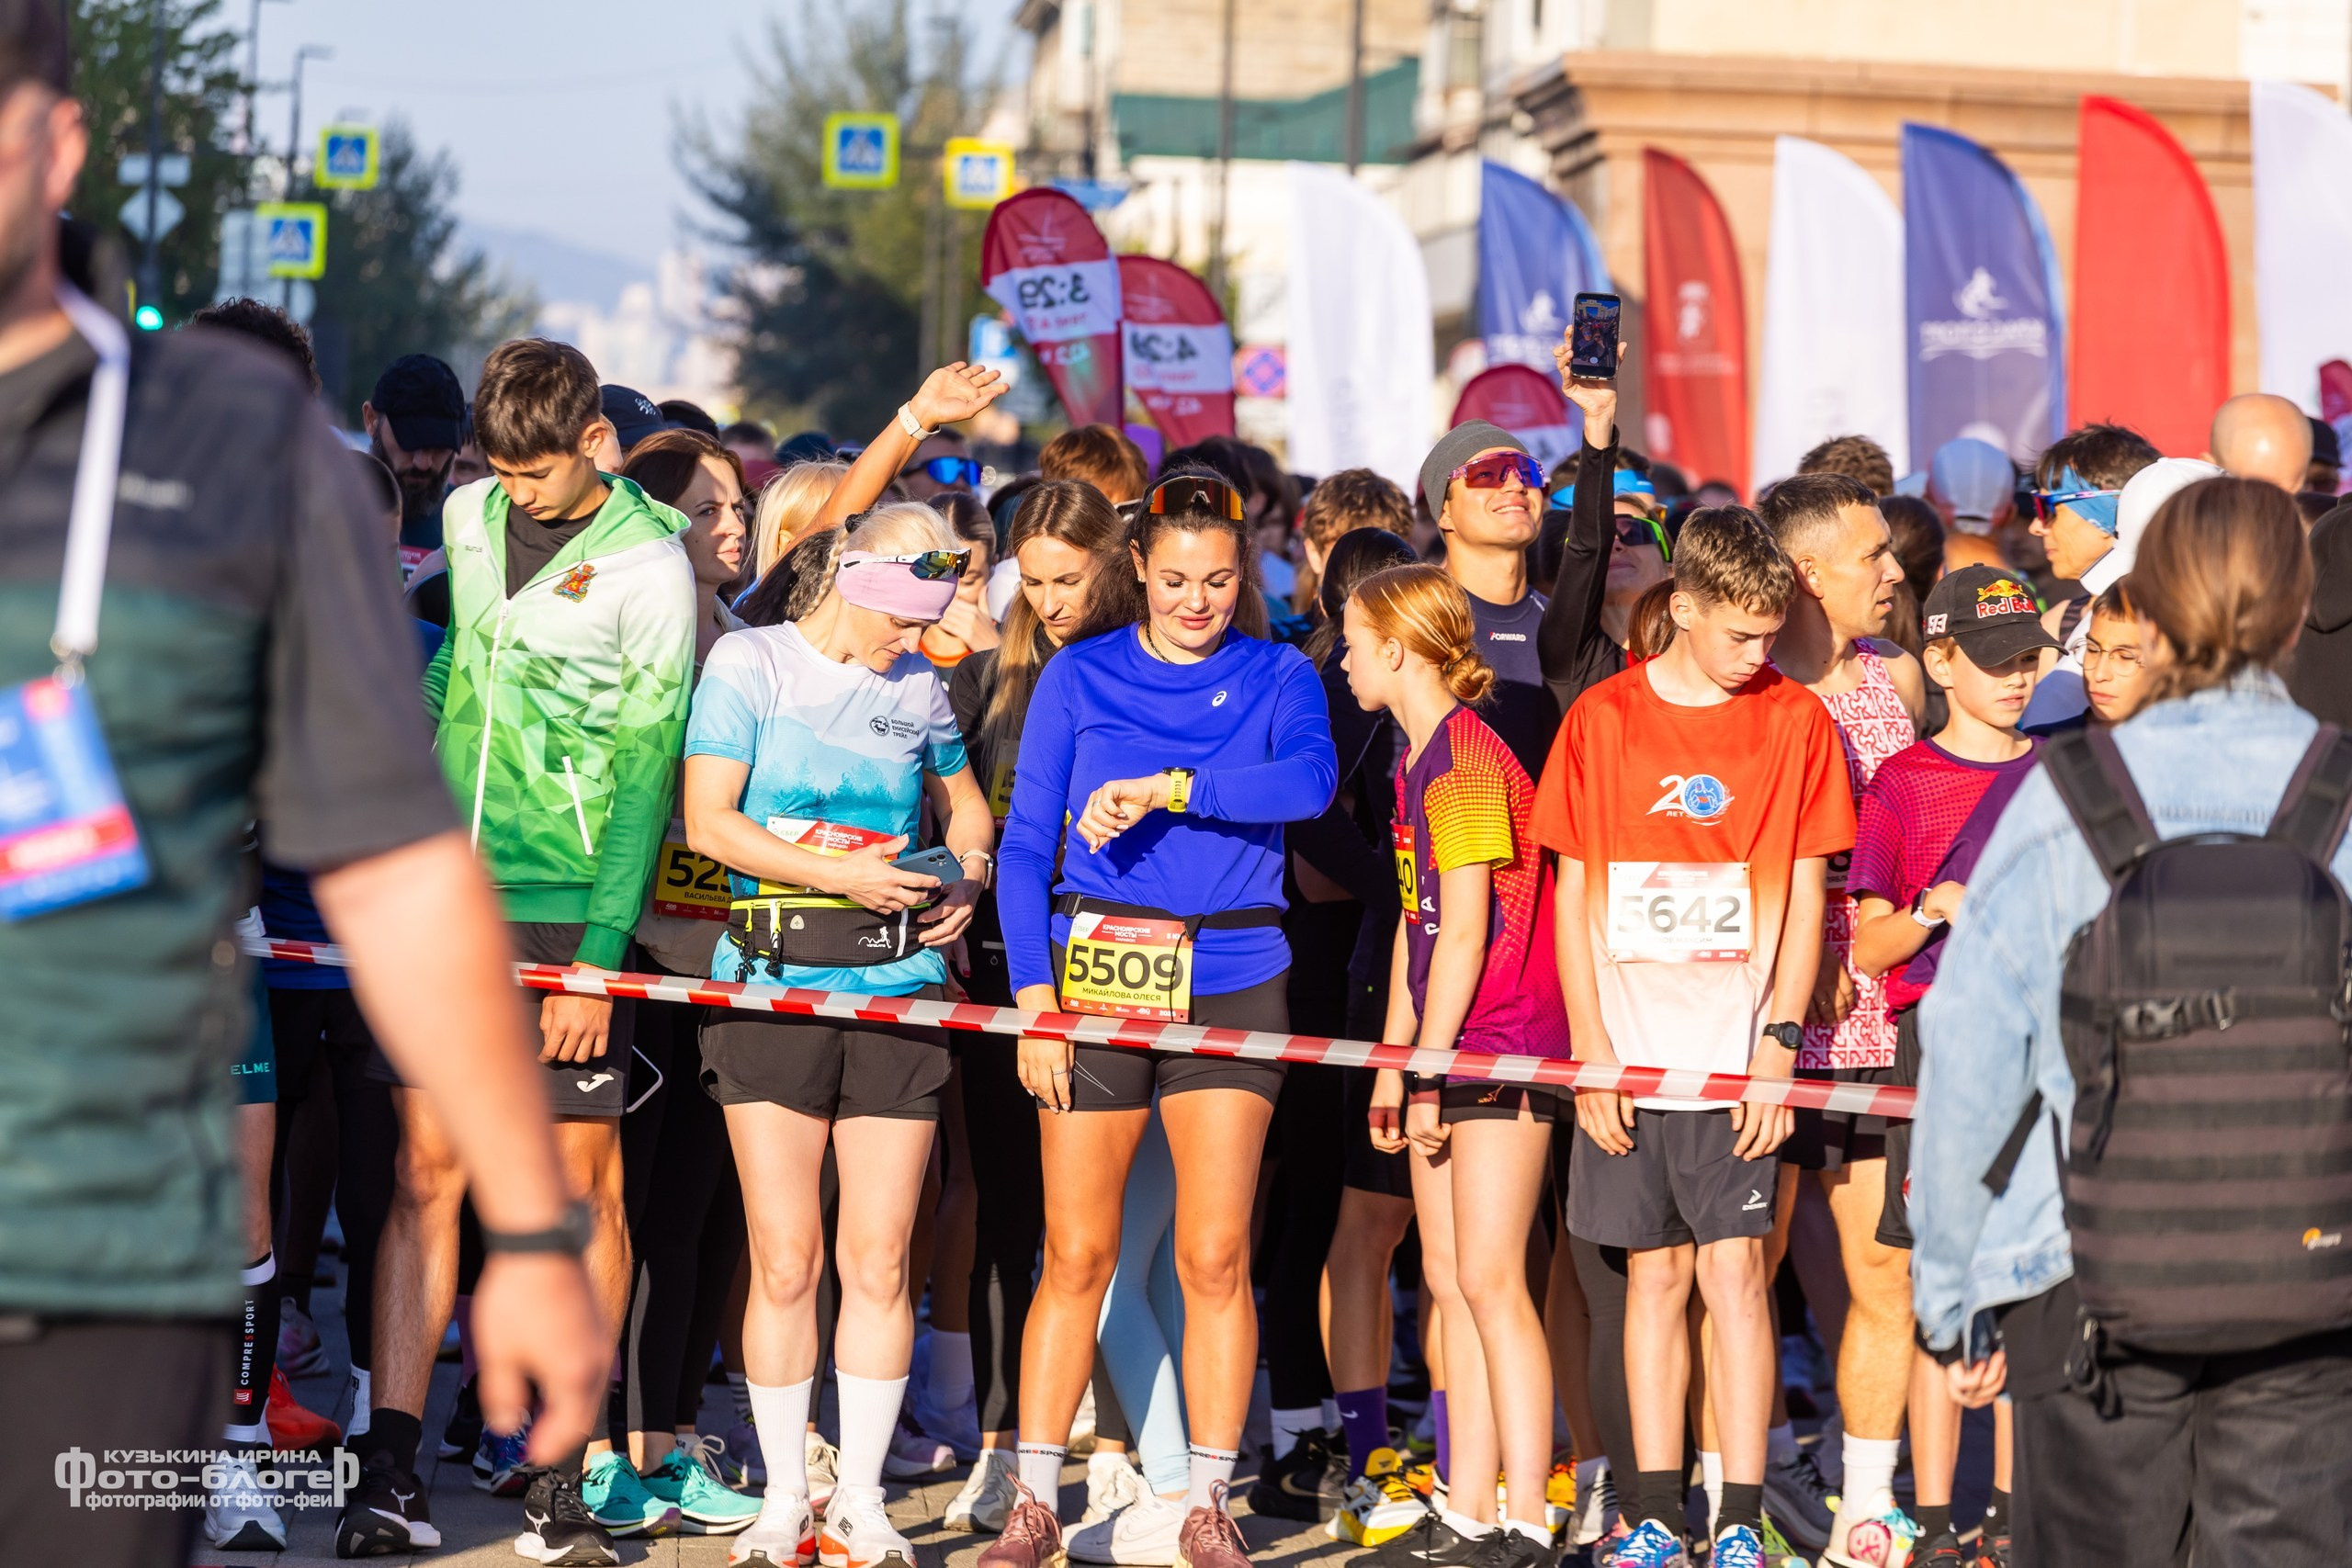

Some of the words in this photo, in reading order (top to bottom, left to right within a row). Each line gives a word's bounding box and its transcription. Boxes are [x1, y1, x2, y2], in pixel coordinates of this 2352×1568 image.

[1976, 598, 2010, 618] Red
[1928, 614, 1948, 635] 93
[1489, 631, 1526, 642] FORWARD
[891, 718, 914, 728] БОЛЬШОЙ
[815, 829, 863, 842] КРАСНОЯРСКИЕ
[684, 892, 726, 902] ВАСИЛЬЕВА
[1617, 895, 1741, 933] 5642
[1102, 924, 1150, 934] КРАСНОЯРСКИЕ
[1069, 943, 1184, 992] 5509
[1082, 987, 1132, 999] МИКАЙЛОВА
[1133, 993, 1161, 1001] ОЛЕСЯ
[241, 1300, 254, 1385] COMPRESSPORT
